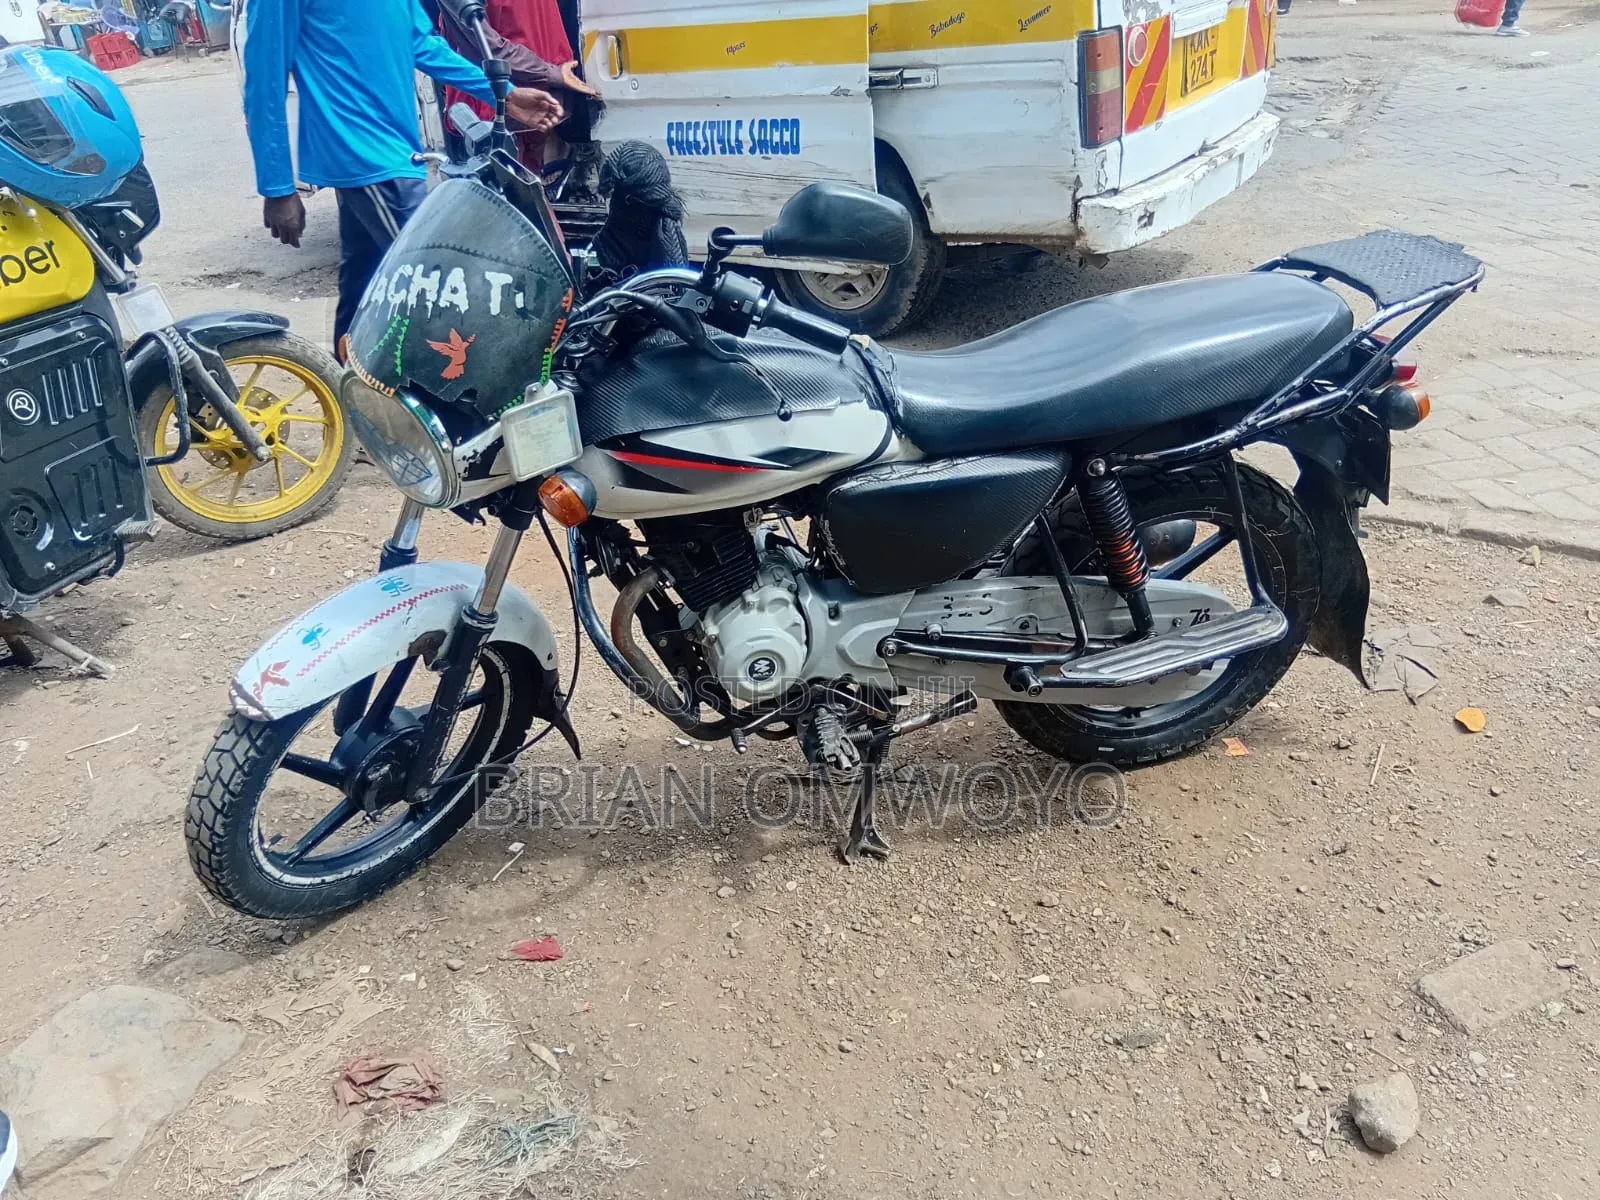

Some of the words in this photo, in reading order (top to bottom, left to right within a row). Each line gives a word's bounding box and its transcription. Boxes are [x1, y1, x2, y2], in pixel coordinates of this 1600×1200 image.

[1190, 49, 1217, 88] 274T
[667, 119, 743, 156] FREESTYLE
[748, 117, 801, 155] SACCO
[0, 239, 61, 287] ber
